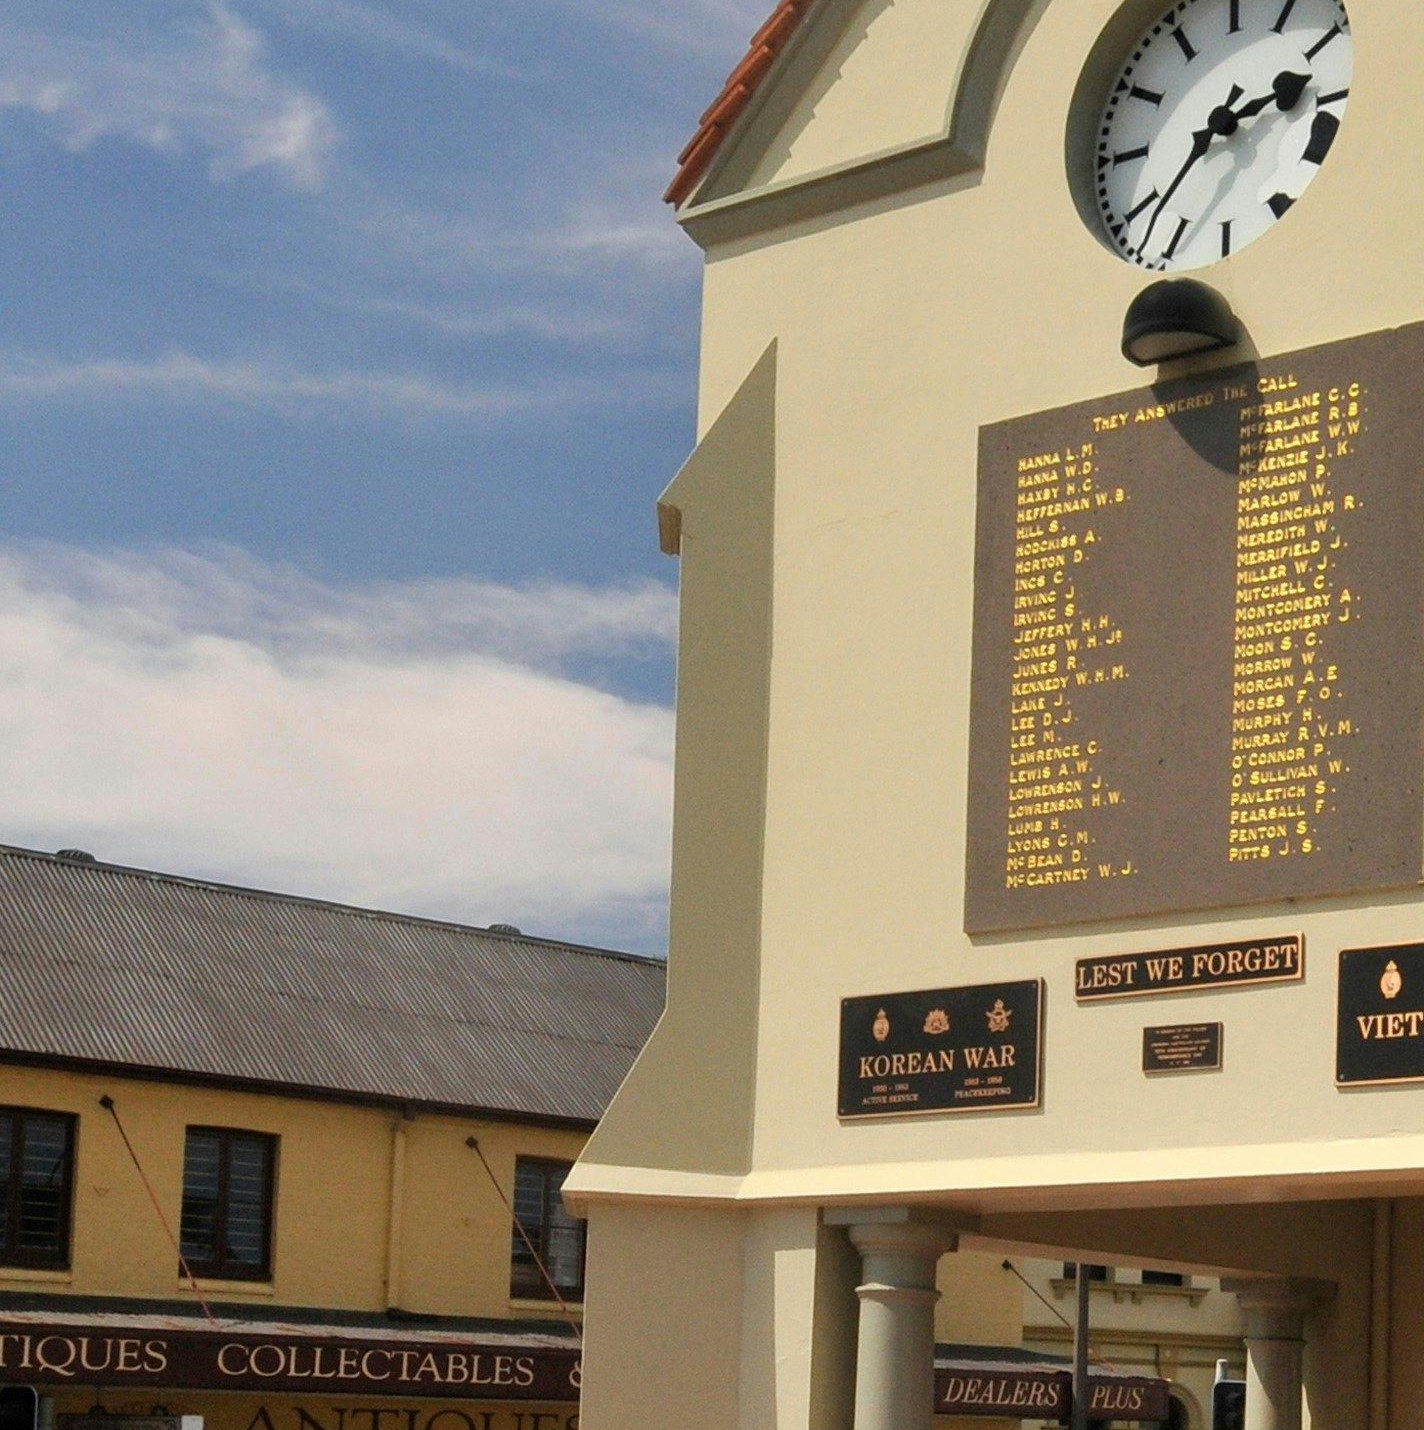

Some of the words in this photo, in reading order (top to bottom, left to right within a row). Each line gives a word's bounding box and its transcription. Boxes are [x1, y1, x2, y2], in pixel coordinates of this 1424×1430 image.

[1093, 412, 1129, 432] THEY
[1135, 394, 1213, 422] ANSWERED
[1223, 385, 1247, 400] THE
[1257, 374, 1297, 393] CALL
[1018, 452, 1060, 472] HANNA
[1018, 470, 1058, 488] HANNA
[1017, 498, 1089, 523] HEFFERNAN
[1238, 490, 1299, 513] MARLOW
[1017, 526, 1044, 539] HILL
[1237, 525, 1305, 549] MEREDITH
[1237, 540, 1320, 567] MERRIFIELD
[1237, 565, 1286, 585] MILLER
[1236, 581, 1305, 603] MITCHELL
[1014, 623, 1073, 643] JEFFERY
[1014, 643, 1055, 661] JONES
[1234, 642, 1273, 658] MOON
[1234, 657, 1292, 676] MORROW
[1012, 676, 1068, 696] KENNEDY
[1233, 695, 1285, 713] MOSES
[1012, 717, 1034, 731] LEE
[1233, 712, 1292, 732] MURPHY
[1011, 734, 1035, 748] LEE
[1232, 731, 1289, 751] MURRAY
[1011, 745, 1080, 766] LAWRENCE
[1010, 767, 1050, 783] LEWIS
[1009, 781, 1081, 800] LOWRENSON
[1009, 798, 1083, 818] LOWRENSON
[1231, 804, 1305, 824] PEARSALL
[1229, 825, 1286, 842] PENTON
[1007, 837, 1050, 853] LYONS
[1229, 845, 1270, 861] PITTS
[1077, 962, 1137, 990] LEST
[1145, 957, 1183, 981] WE
[1192, 944, 1298, 978] FORGET
[859, 1049, 956, 1079] KOREAN
[963, 1044, 1016, 1069] WAR
[217, 1343, 535, 1386] COLLECTABLES
[944, 1377, 1060, 1407] DEALERS
[1091, 1385, 1144, 1409] PLUS
